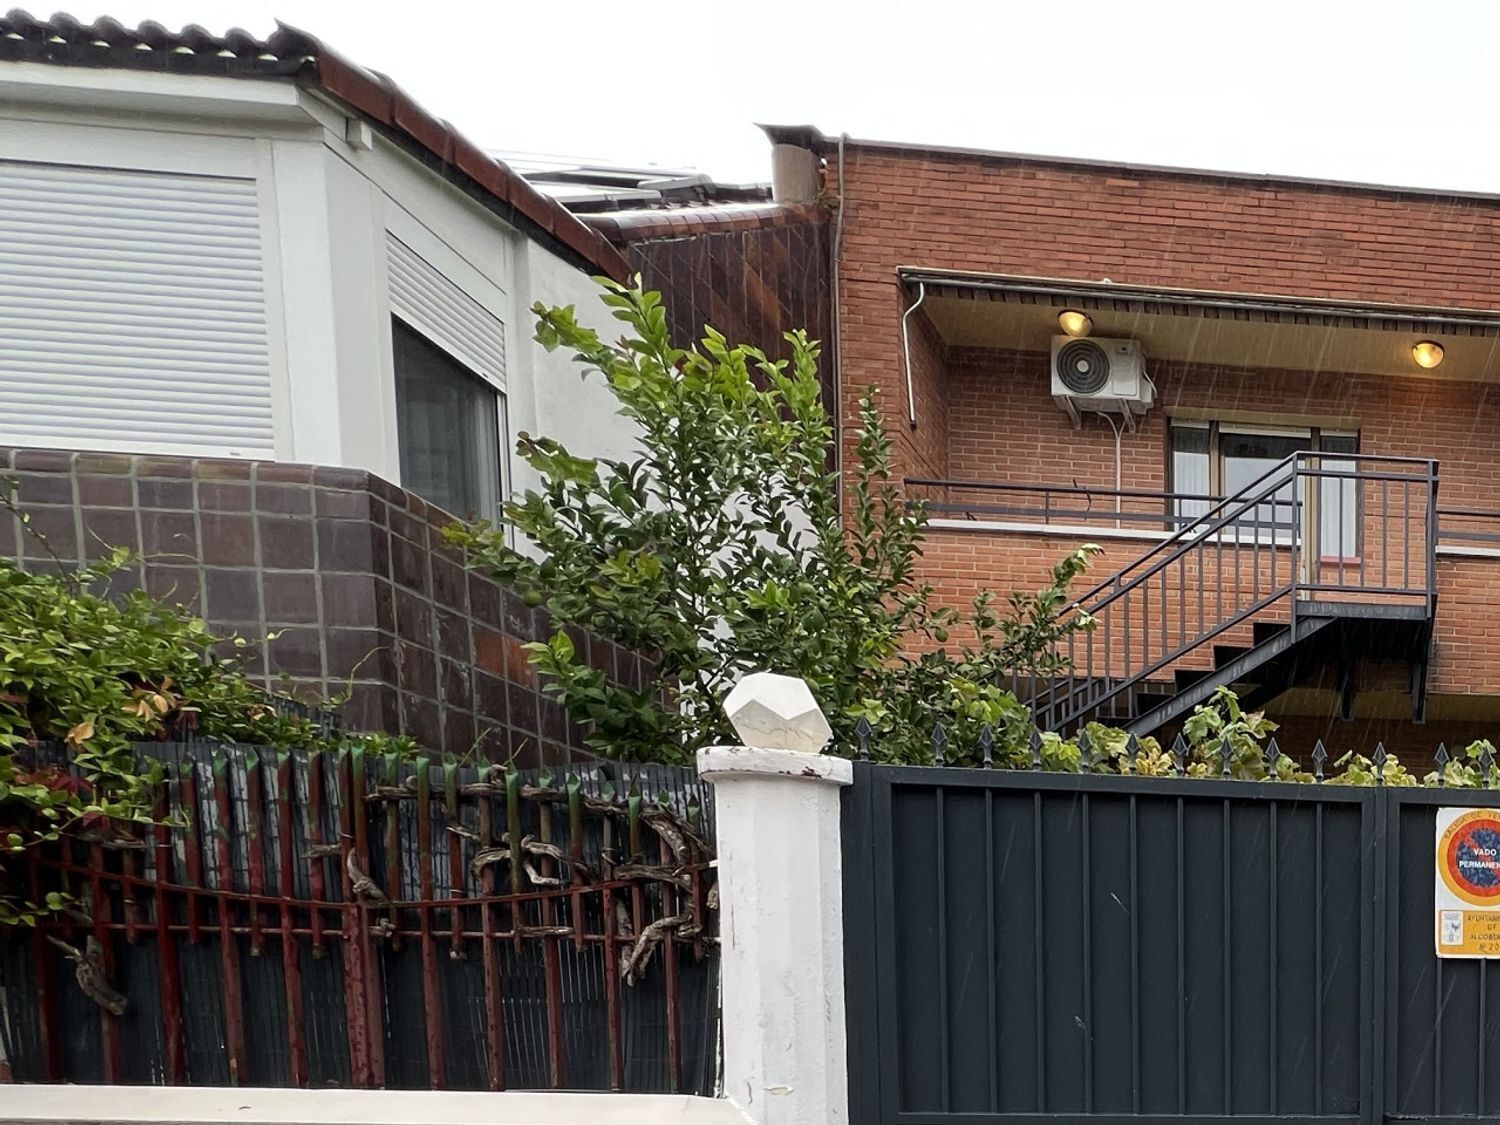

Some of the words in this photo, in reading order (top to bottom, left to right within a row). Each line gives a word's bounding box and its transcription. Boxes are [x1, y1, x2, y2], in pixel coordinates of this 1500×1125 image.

[1470, 810, 1481, 818] DE
[1473, 848, 1498, 856] VADO
[1487, 923, 1497, 931] DE
